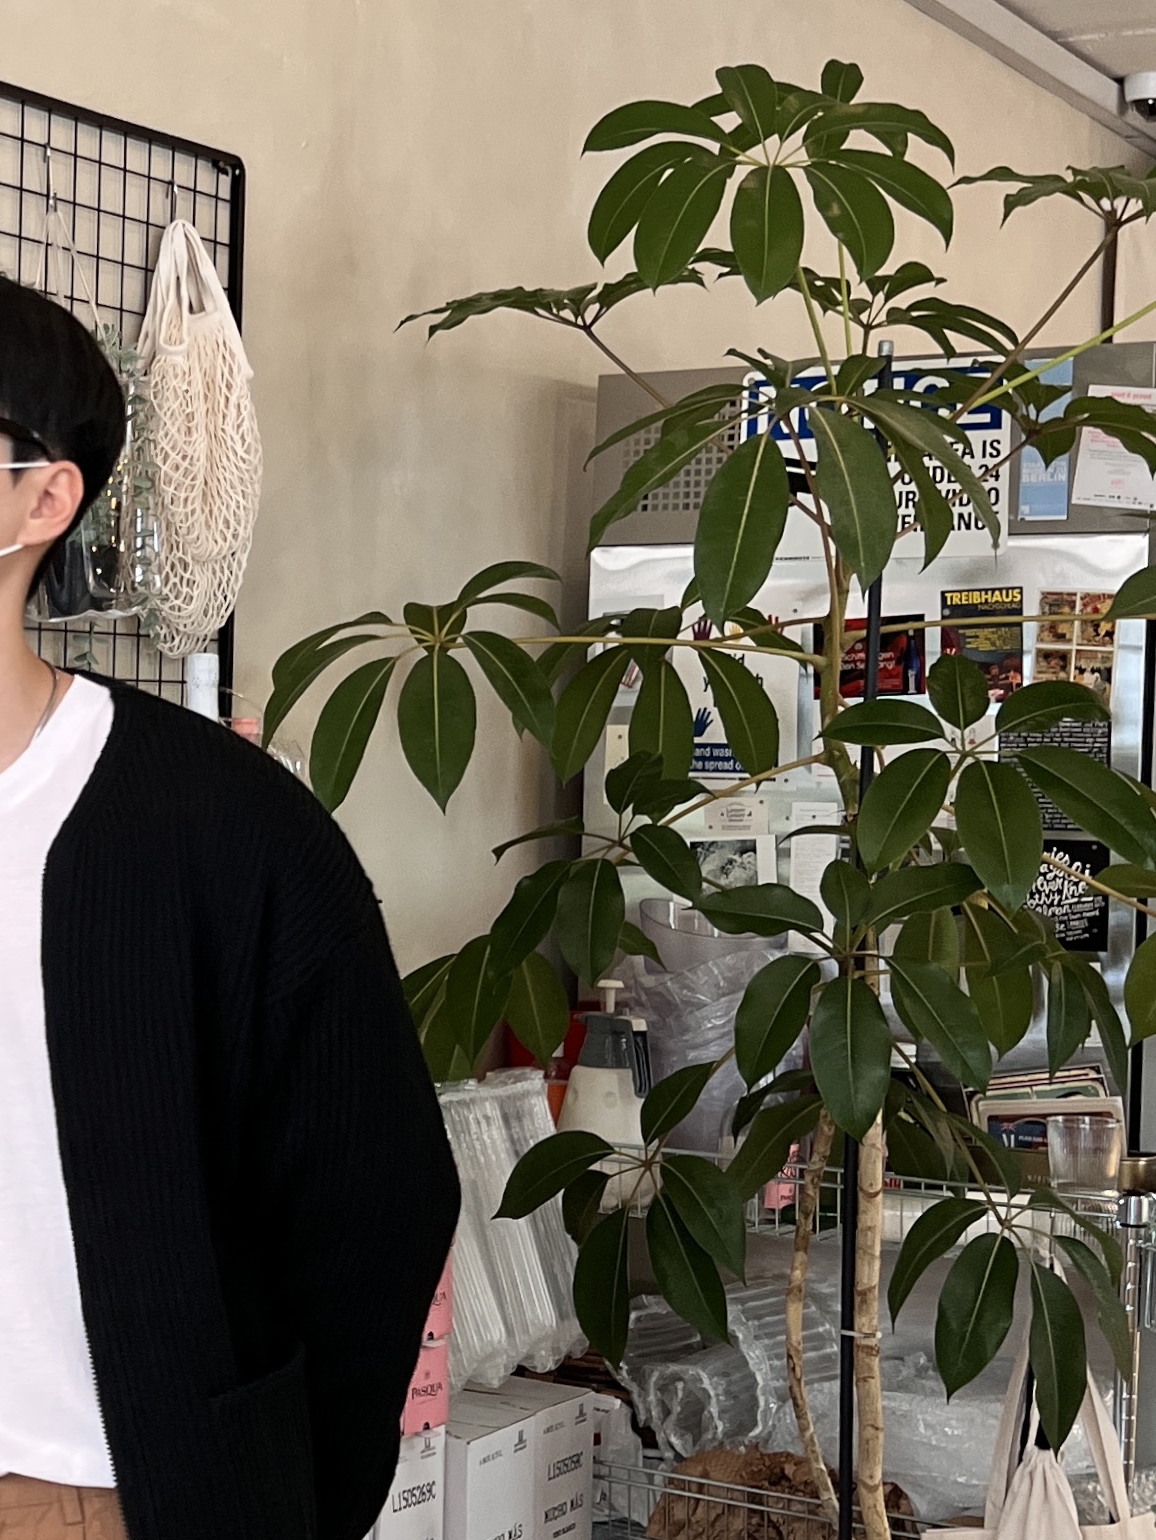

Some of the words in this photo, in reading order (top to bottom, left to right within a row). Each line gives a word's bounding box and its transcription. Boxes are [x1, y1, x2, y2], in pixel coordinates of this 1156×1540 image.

[982, 439, 1001, 459] IS
[978, 464, 1000, 484] 24
[944, 589, 1022, 605] TREIBHAUS
[704, 761, 733, 772] spread
[411, 1382, 444, 1400] PASQUA
